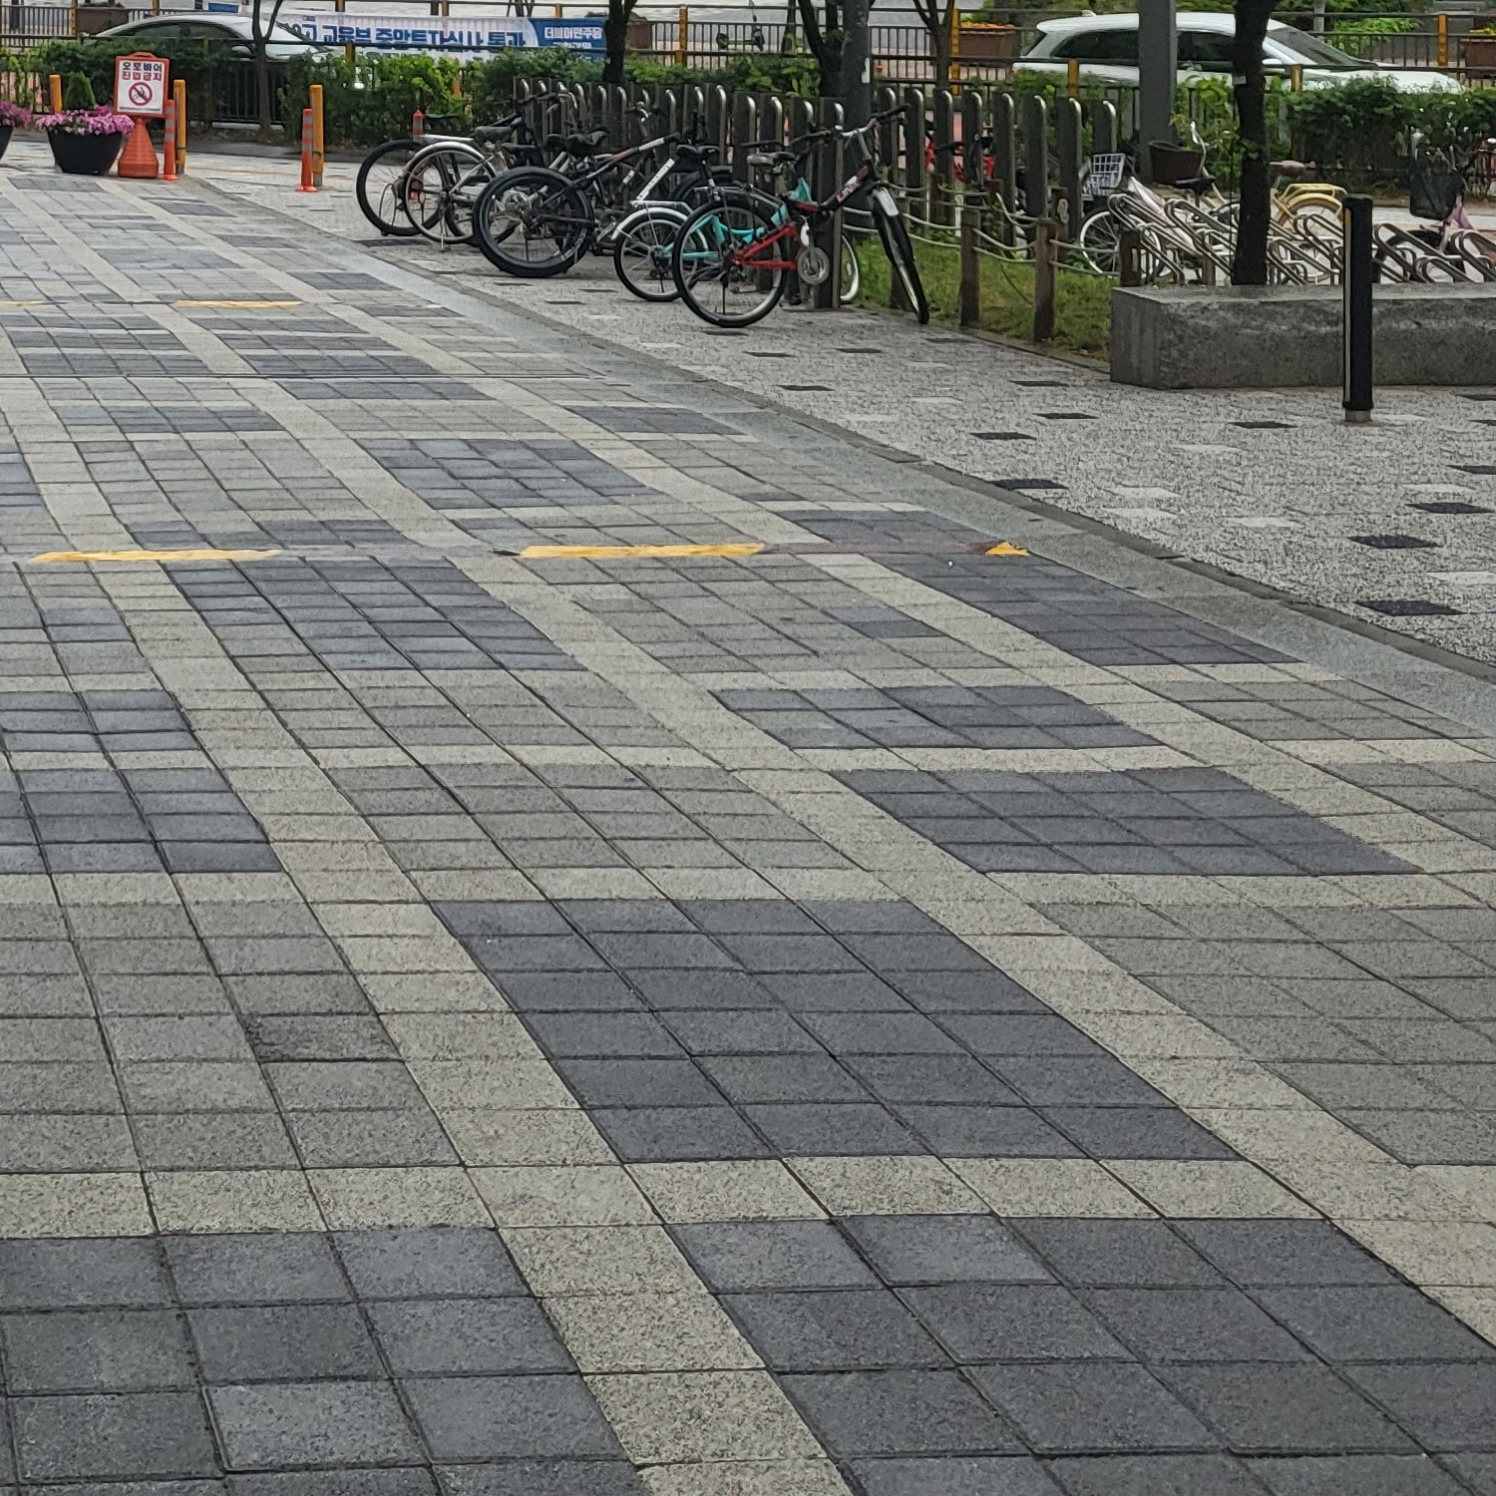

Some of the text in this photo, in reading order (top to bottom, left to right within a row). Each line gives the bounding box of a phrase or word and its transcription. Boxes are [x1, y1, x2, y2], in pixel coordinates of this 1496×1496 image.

[544, 26, 604, 40] 더불어민주당
[122, 61, 162, 72] 오토바이
[122, 71, 162, 82] 진입금지
